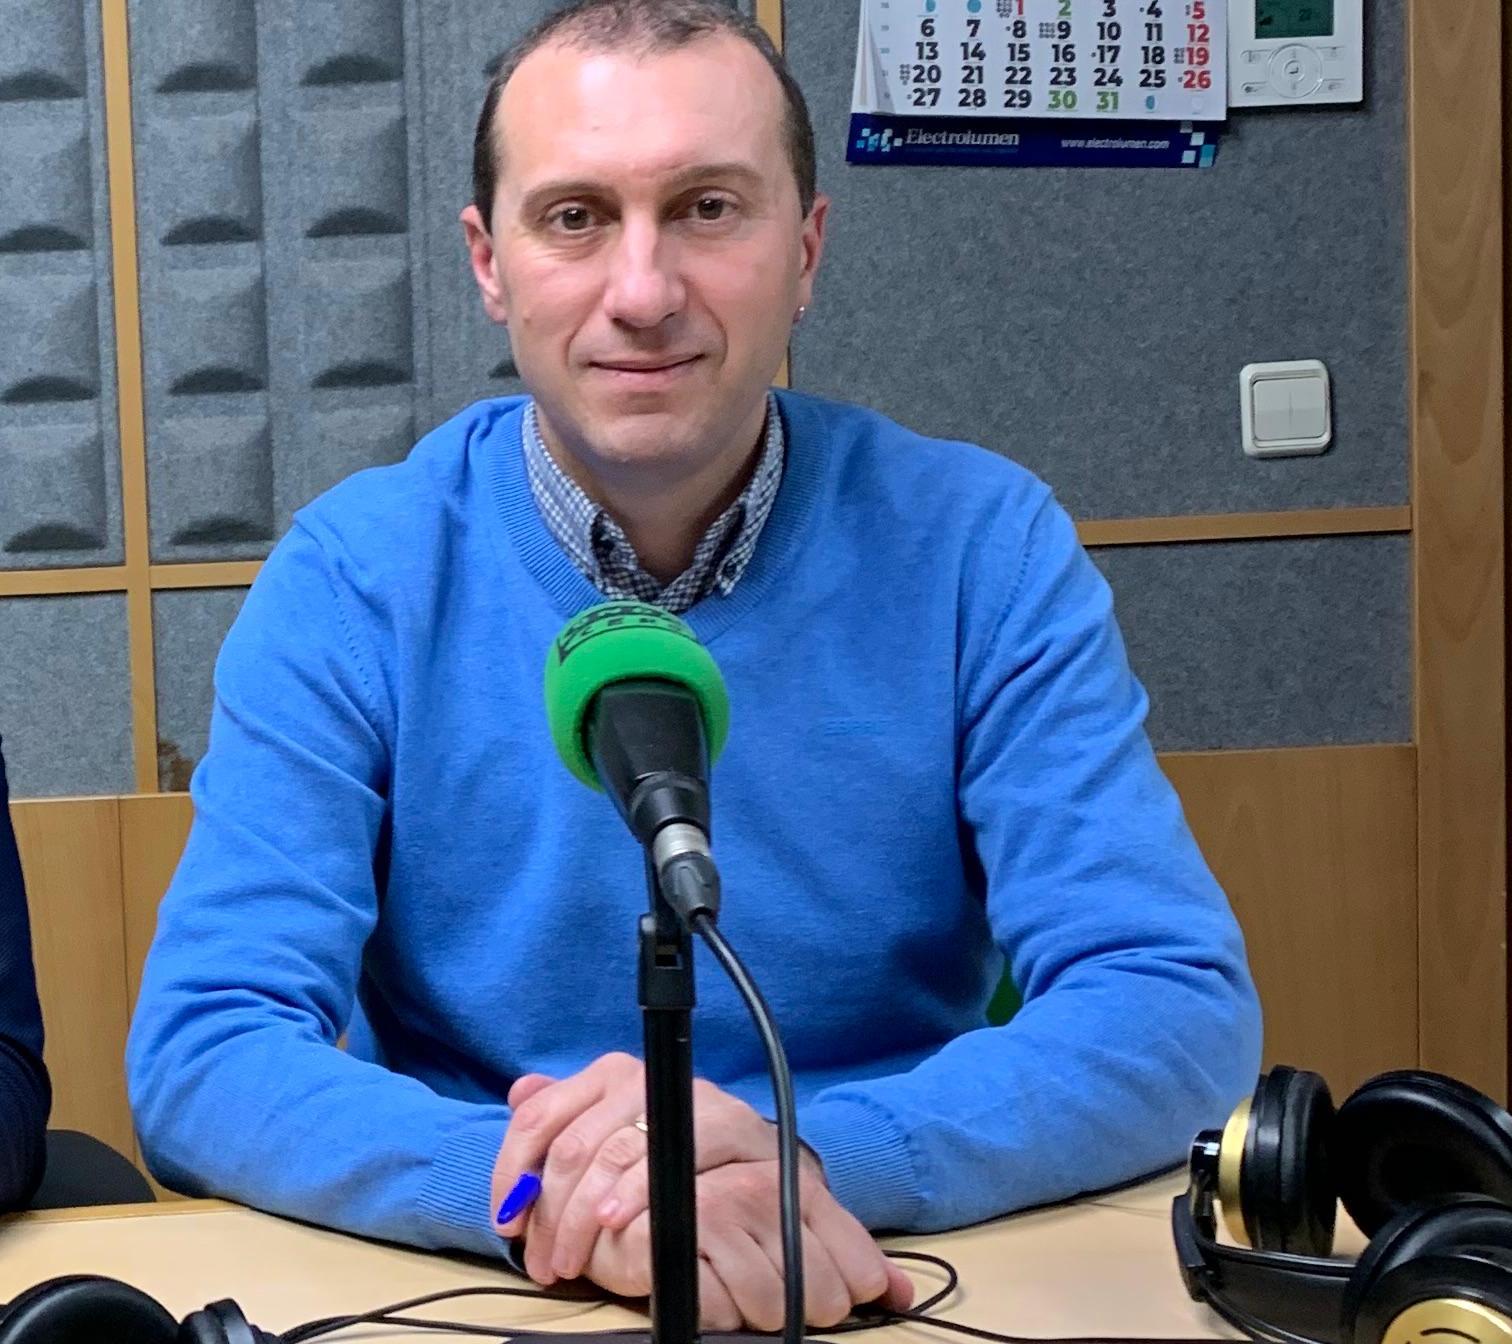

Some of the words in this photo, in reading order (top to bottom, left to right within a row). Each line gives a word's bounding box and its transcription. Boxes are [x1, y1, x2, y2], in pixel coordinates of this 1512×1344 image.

[1102, 0, 1116, 17] 3
[1146, 0, 1162, 18] 4
[1191, 1, 1205, 19] 5
[921, 18, 935, 37] 6
[966, 19, 981, 37] 7
[1012, 20, 1026, 39] 8
[1057, 21, 1071, 39] 9
[1097, 21, 1121, 40] 10
[1145, 22, 1163, 41] 11
[1187, 24, 1210, 42] 12
[915, 41, 939, 60] 13
[960, 42, 986, 61] 14
[1007, 43, 1031, 62] 15
[1051, 44, 1076, 63] 16
[1097, 44, 1121, 64] 17
[1141, 46, 1165, 64] 18
[1185, 47, 1209, 66] 19
[912, 64, 941, 83] 20
[961, 65, 984, 84] 21
[1004, 66, 1032, 85] 22
[1050, 67, 1076, 86] 23
[1093, 68, 1123, 87] 24
[1139, 69, 1166, 87] 25
[1183, 70, 1211, 89] 26
[912, 87, 941, 106] 27
[958, 88, 986, 107] 28
[1003, 89, 1032, 108] 29
[1048, 90, 1077, 109] 30
[1096, 91, 1119, 110] 31
[905, 128, 1020, 145] Electrolumen
